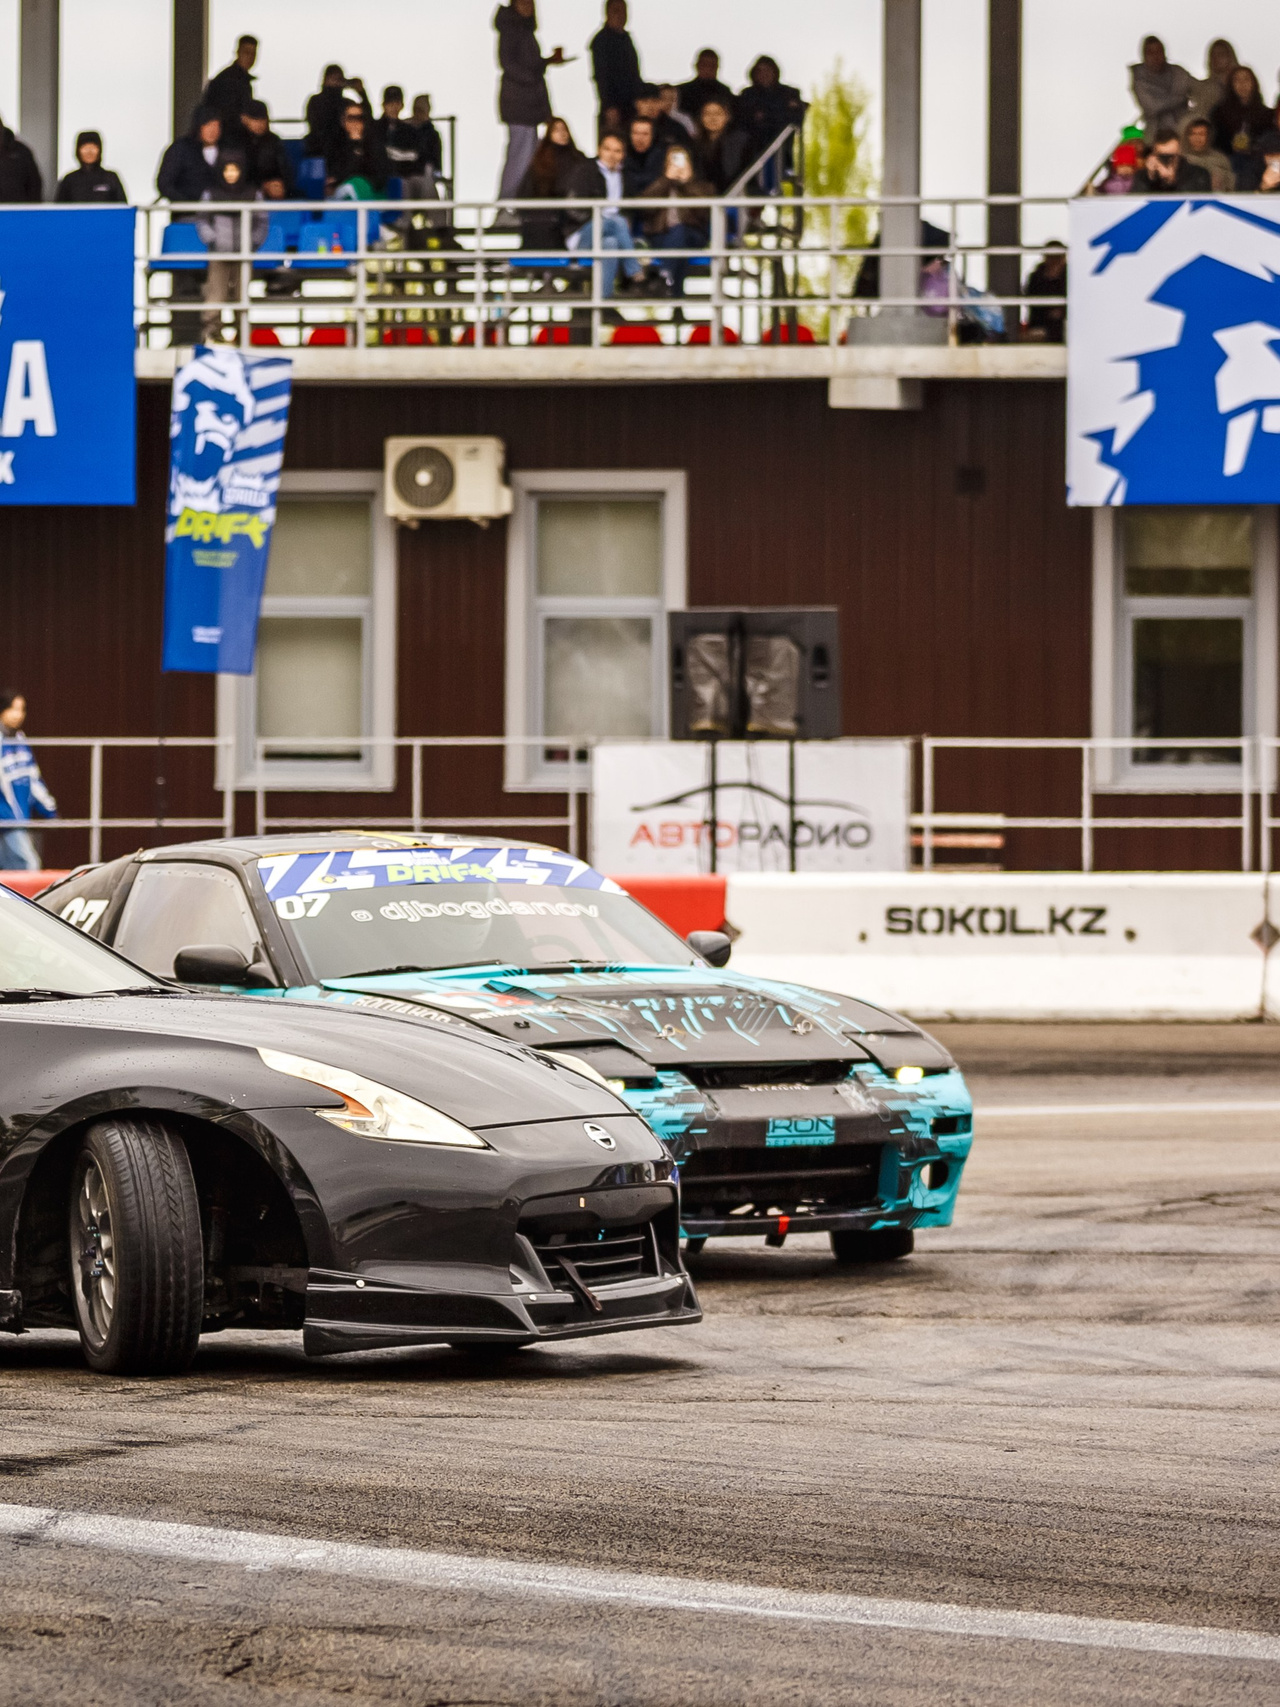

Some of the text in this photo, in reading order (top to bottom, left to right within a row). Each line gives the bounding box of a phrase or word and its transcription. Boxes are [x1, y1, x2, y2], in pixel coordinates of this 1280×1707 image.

[174, 506, 269, 549] DRIFT
[386, 863, 498, 884] DRIFT
[276, 892, 331, 920] 07
[379, 897, 600, 923] djbogdanov
[885, 905, 1108, 936] SOKOL.KZ
